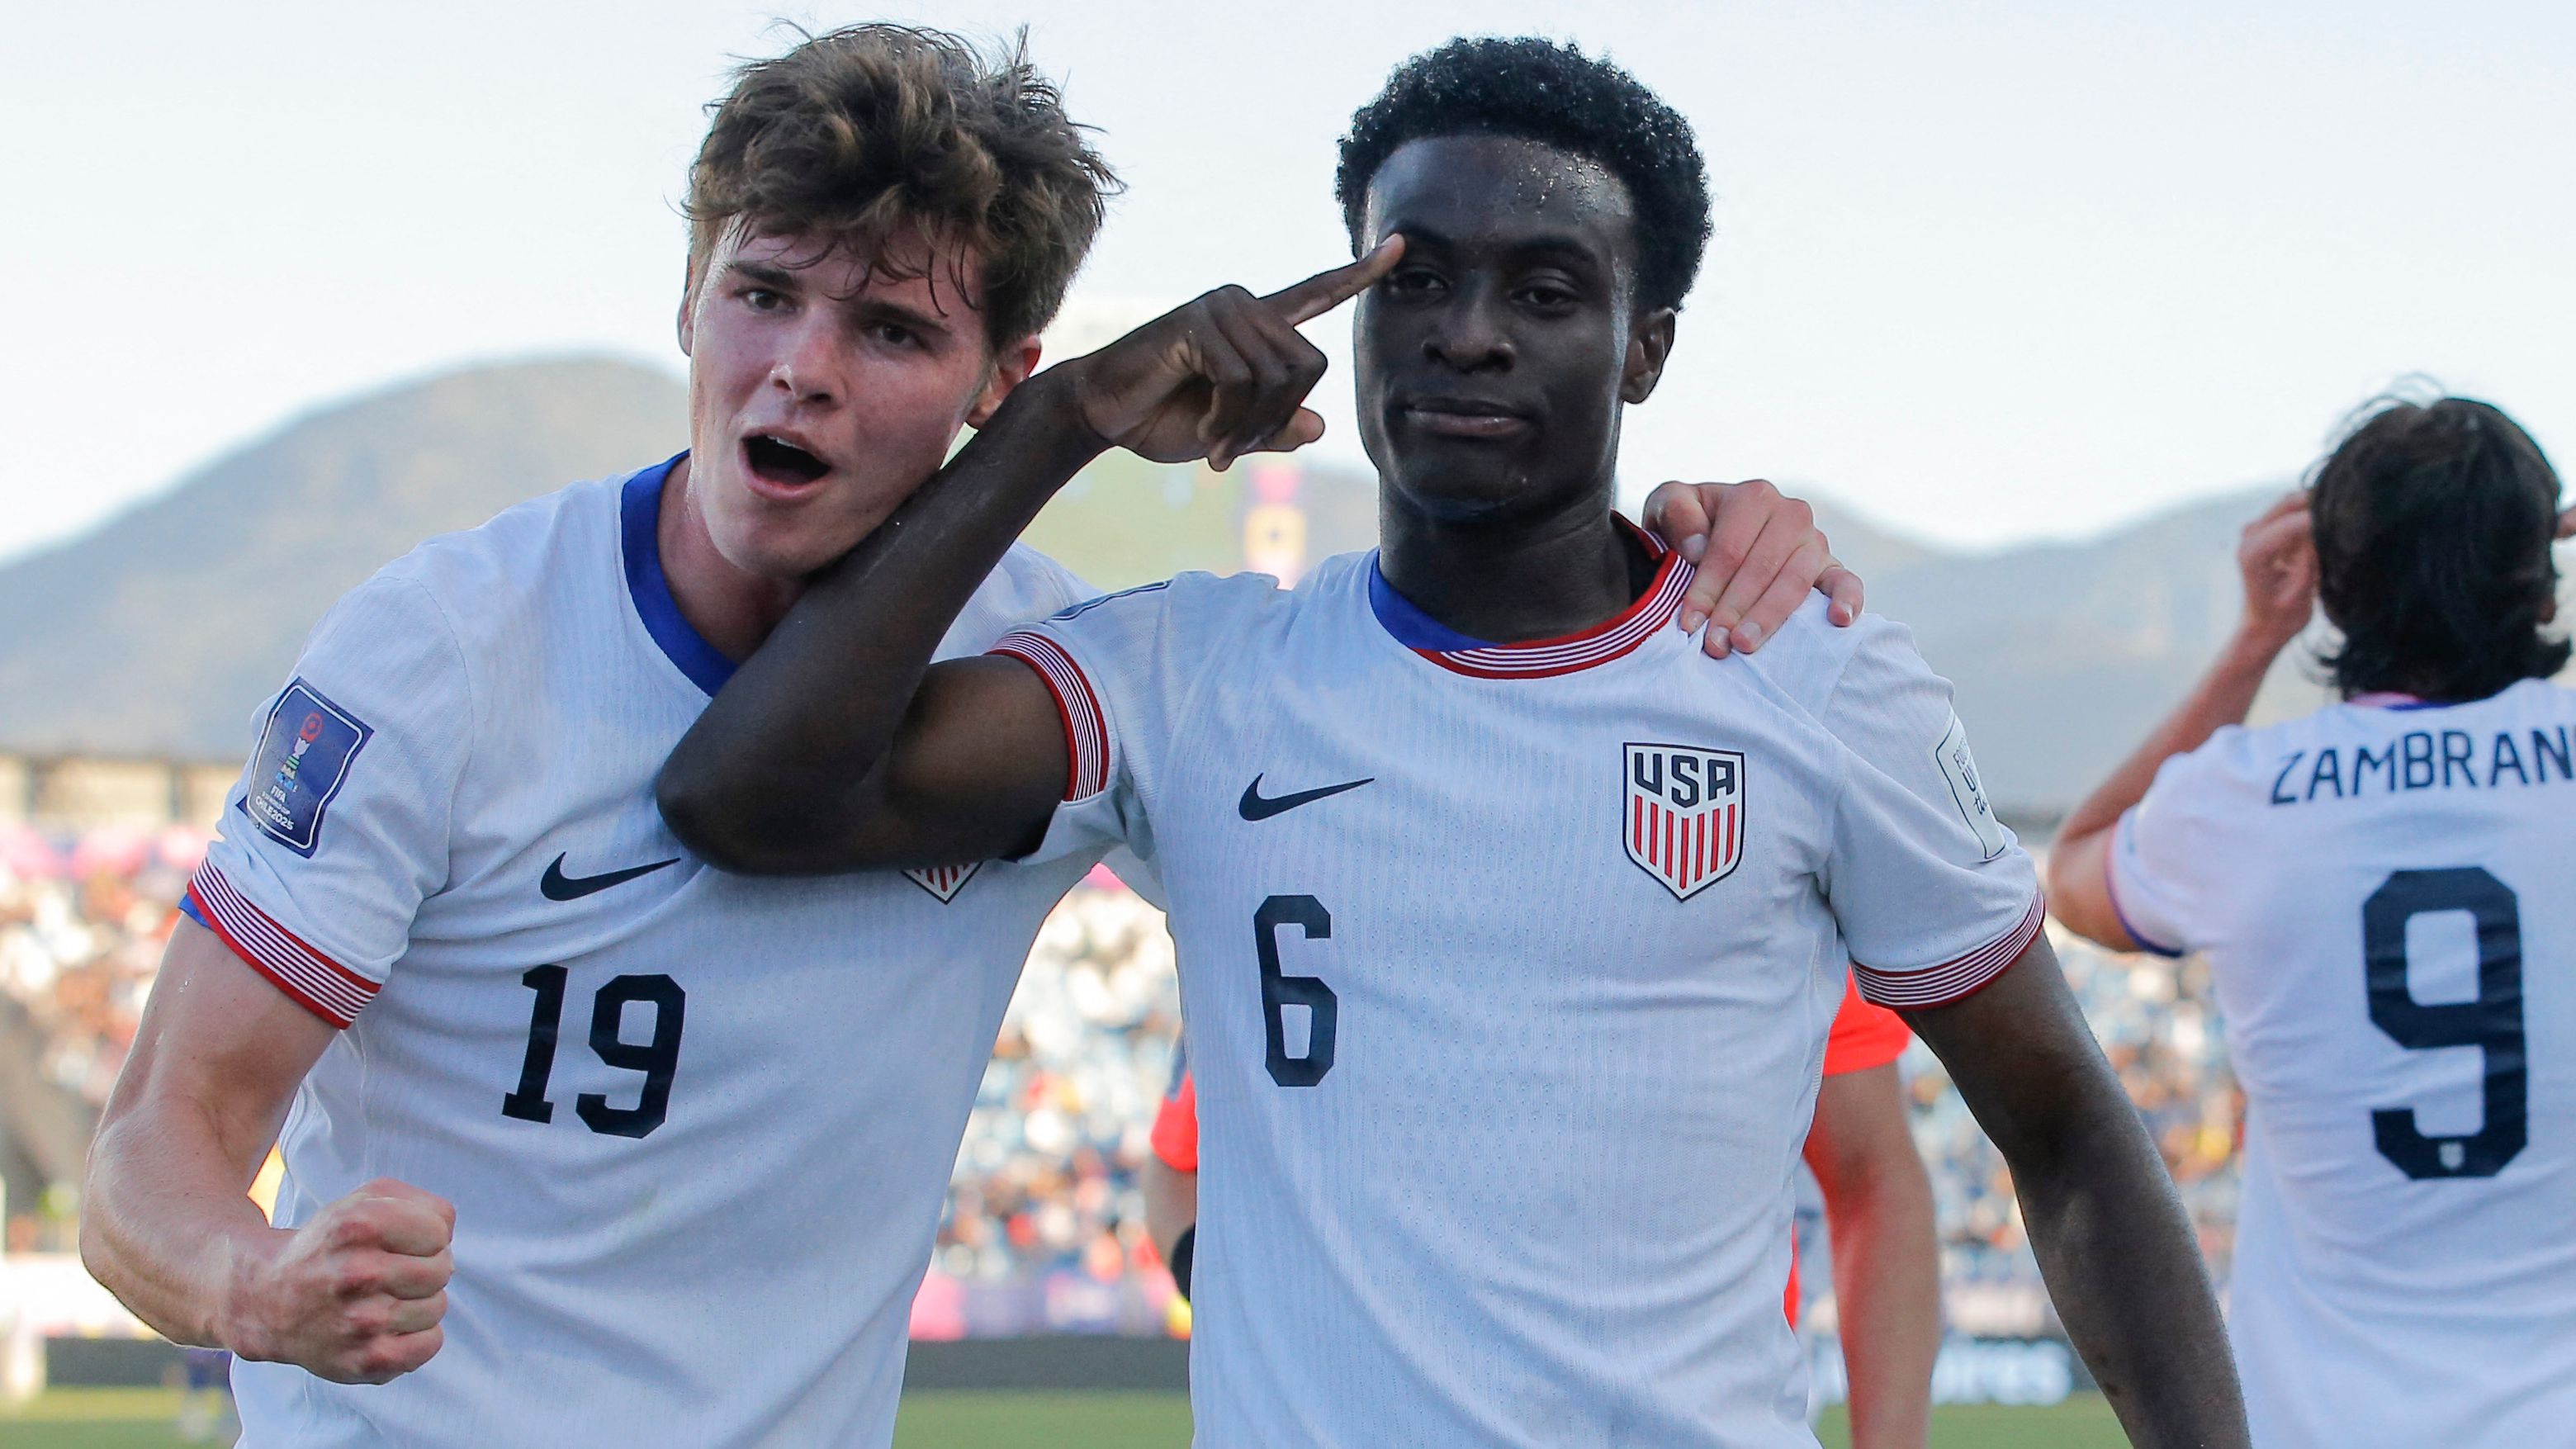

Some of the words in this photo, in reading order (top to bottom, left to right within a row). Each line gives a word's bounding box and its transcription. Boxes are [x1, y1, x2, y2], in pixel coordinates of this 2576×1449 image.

[271, 785, 286, 803] FIFA
[1634, 752, 1735, 808] USA
[2271, 727, 2576, 805] ZAMBRAN
[502, 964, 686, 1139] 19
[1253, 895, 1337, 1087] 6
[2363, 866, 2528, 1180] 9
